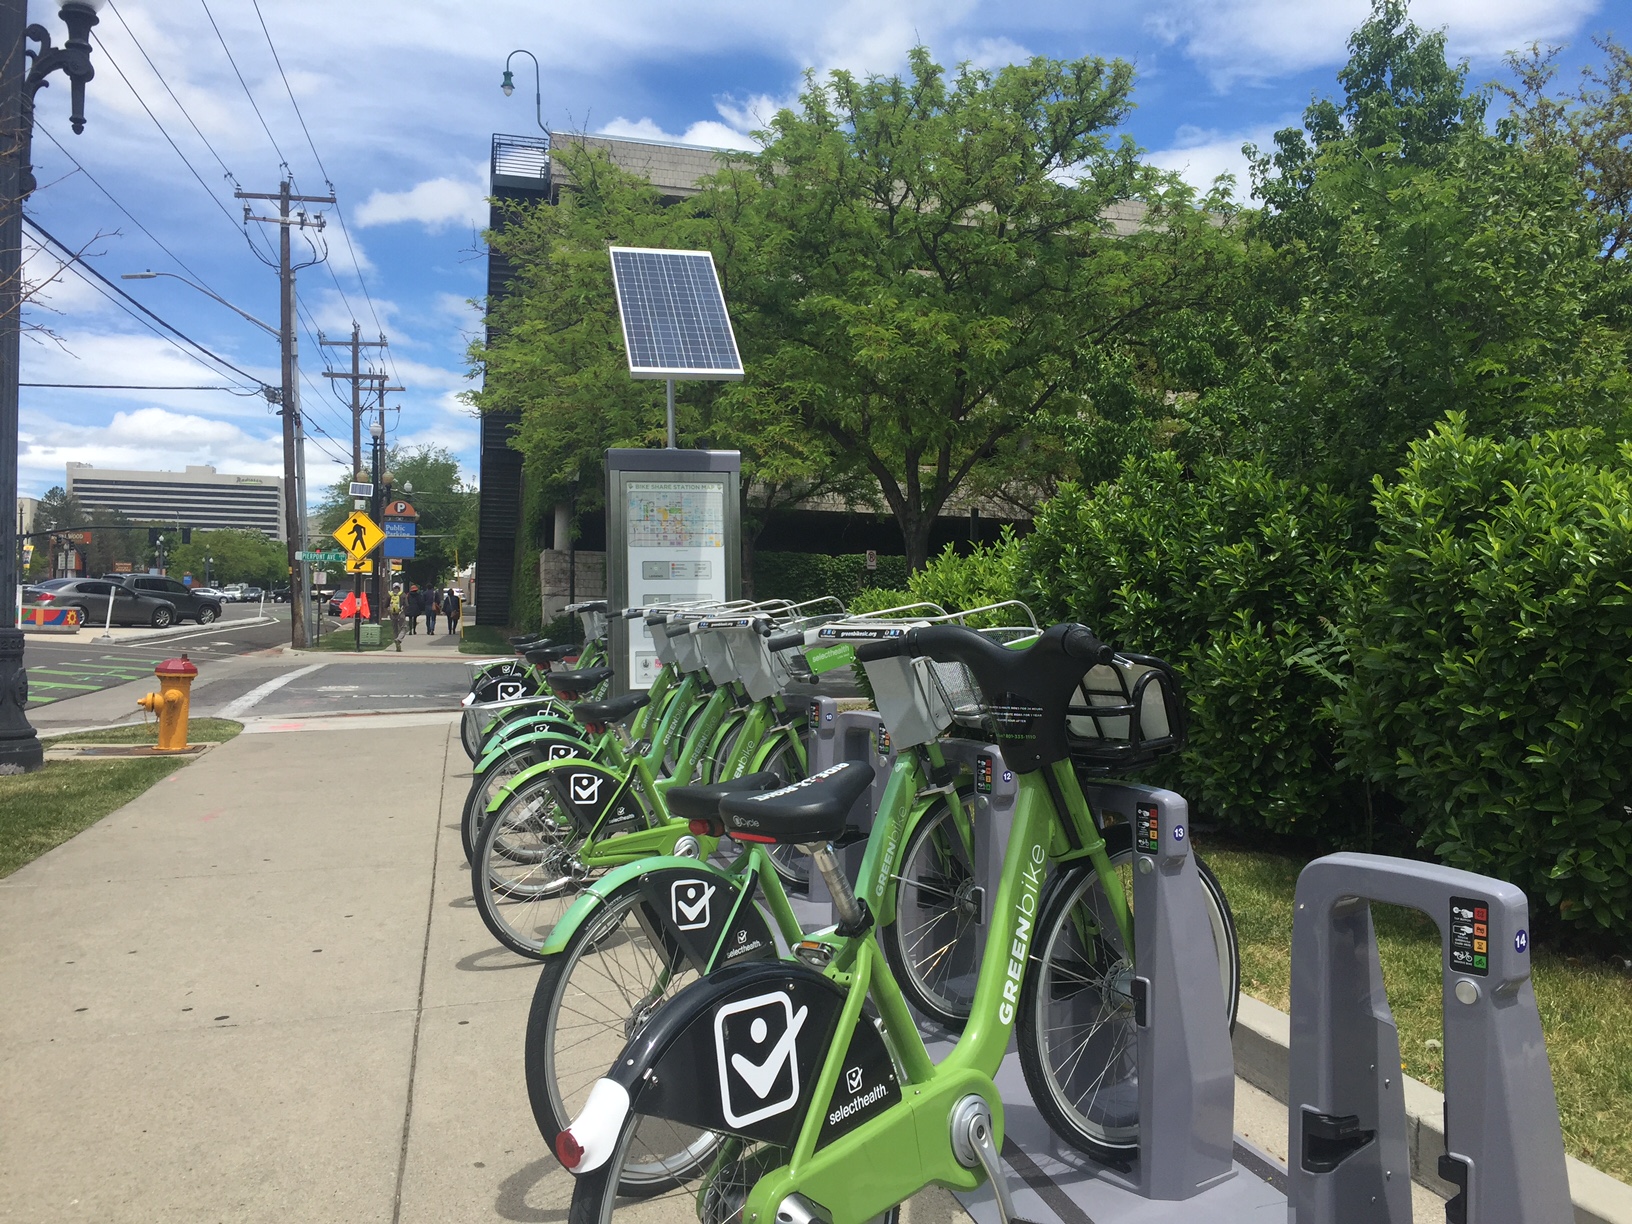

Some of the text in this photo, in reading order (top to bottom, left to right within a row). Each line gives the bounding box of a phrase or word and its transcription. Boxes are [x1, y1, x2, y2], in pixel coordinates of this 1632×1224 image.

[396, 502, 406, 513] P
[385, 524, 406, 532] Public
[812, 644, 851, 662] selecthealth
[663, 701, 687, 746] GREENbike
[1003, 772, 1012, 780] 12
[1174, 828, 1184, 838] 13
[875, 806, 907, 896] GREENbike
[999, 844, 1045, 1025] GREENbike
[1515, 933, 1527, 949] 14
[726, 939, 761, 959] selecthealth
